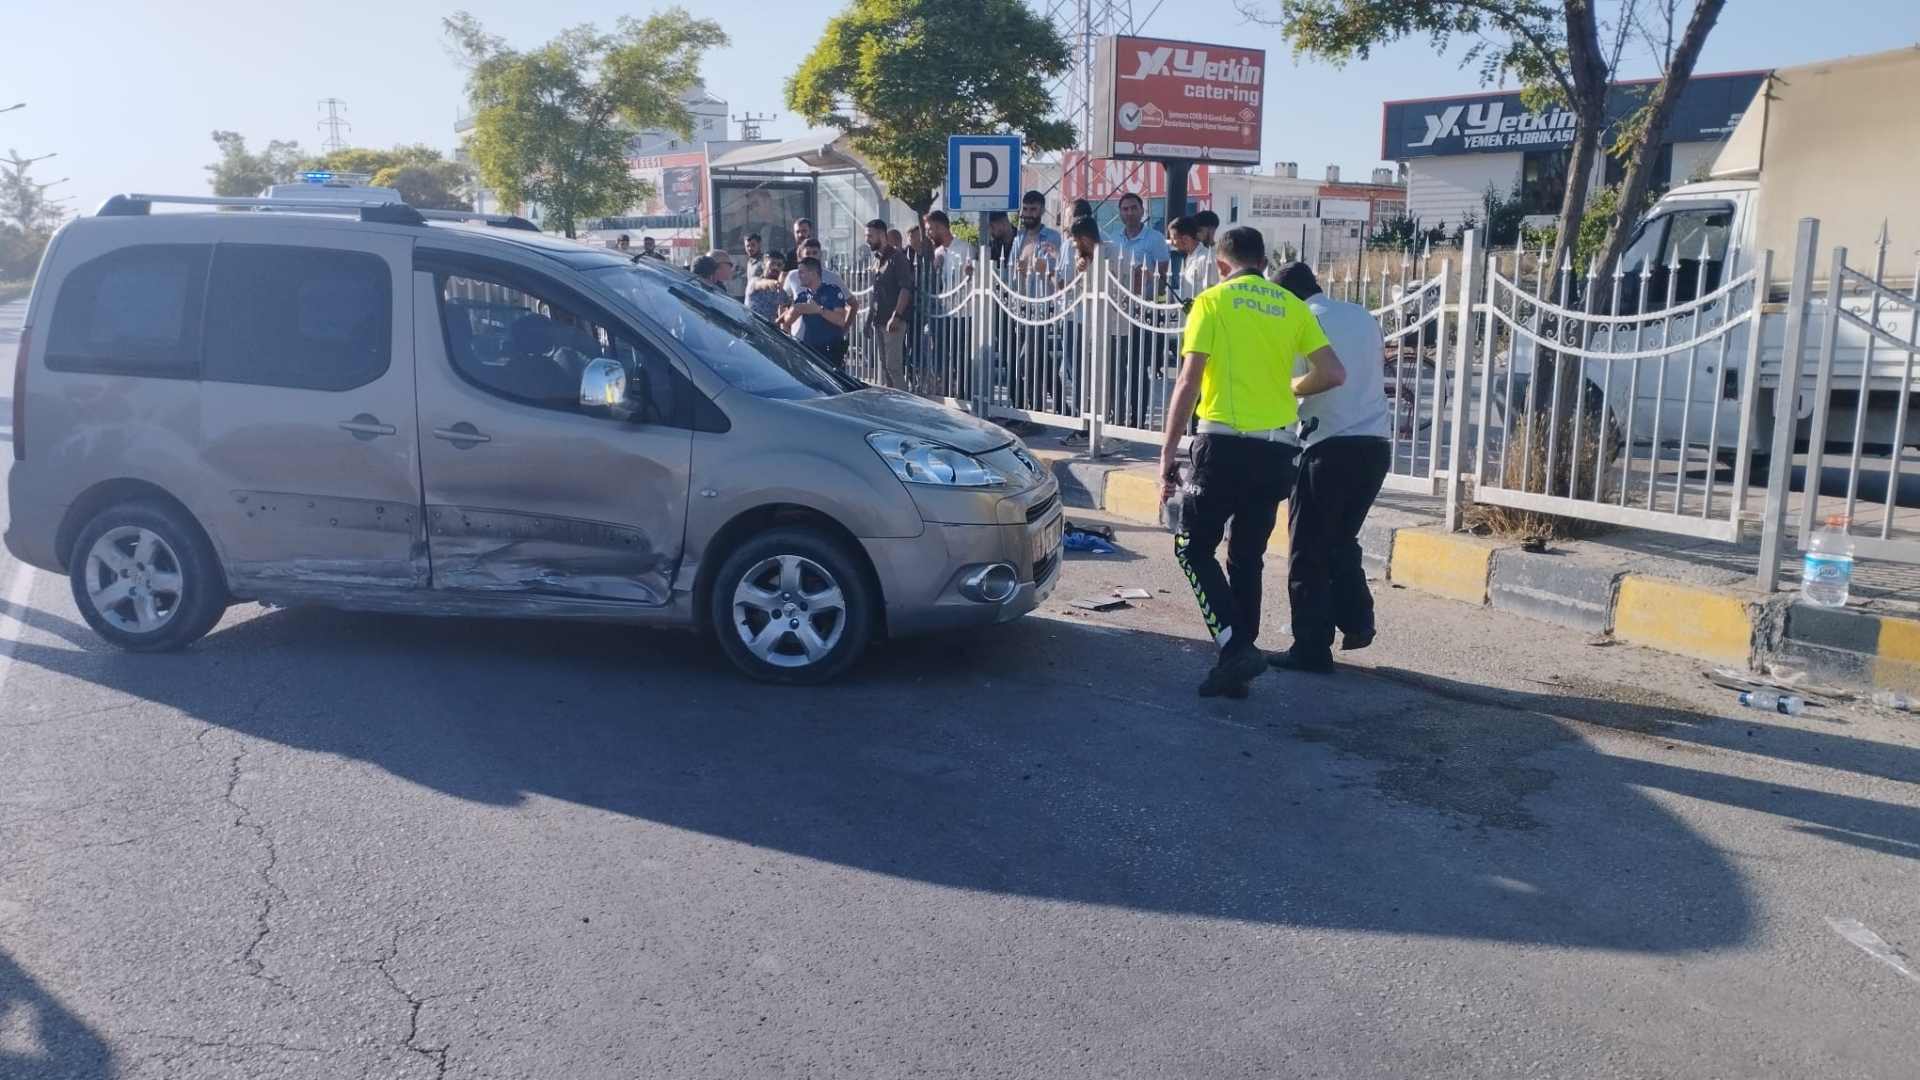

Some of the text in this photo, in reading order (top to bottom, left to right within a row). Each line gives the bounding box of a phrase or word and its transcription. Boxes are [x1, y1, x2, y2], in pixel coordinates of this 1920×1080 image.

[1172, 48, 1262, 85] Yetkin
[1183, 83, 1259, 107] catering
[1464, 102, 1577, 135] Yetkin
[1464, 134, 1504, 149] YEMEK
[970, 151, 999, 189] D
